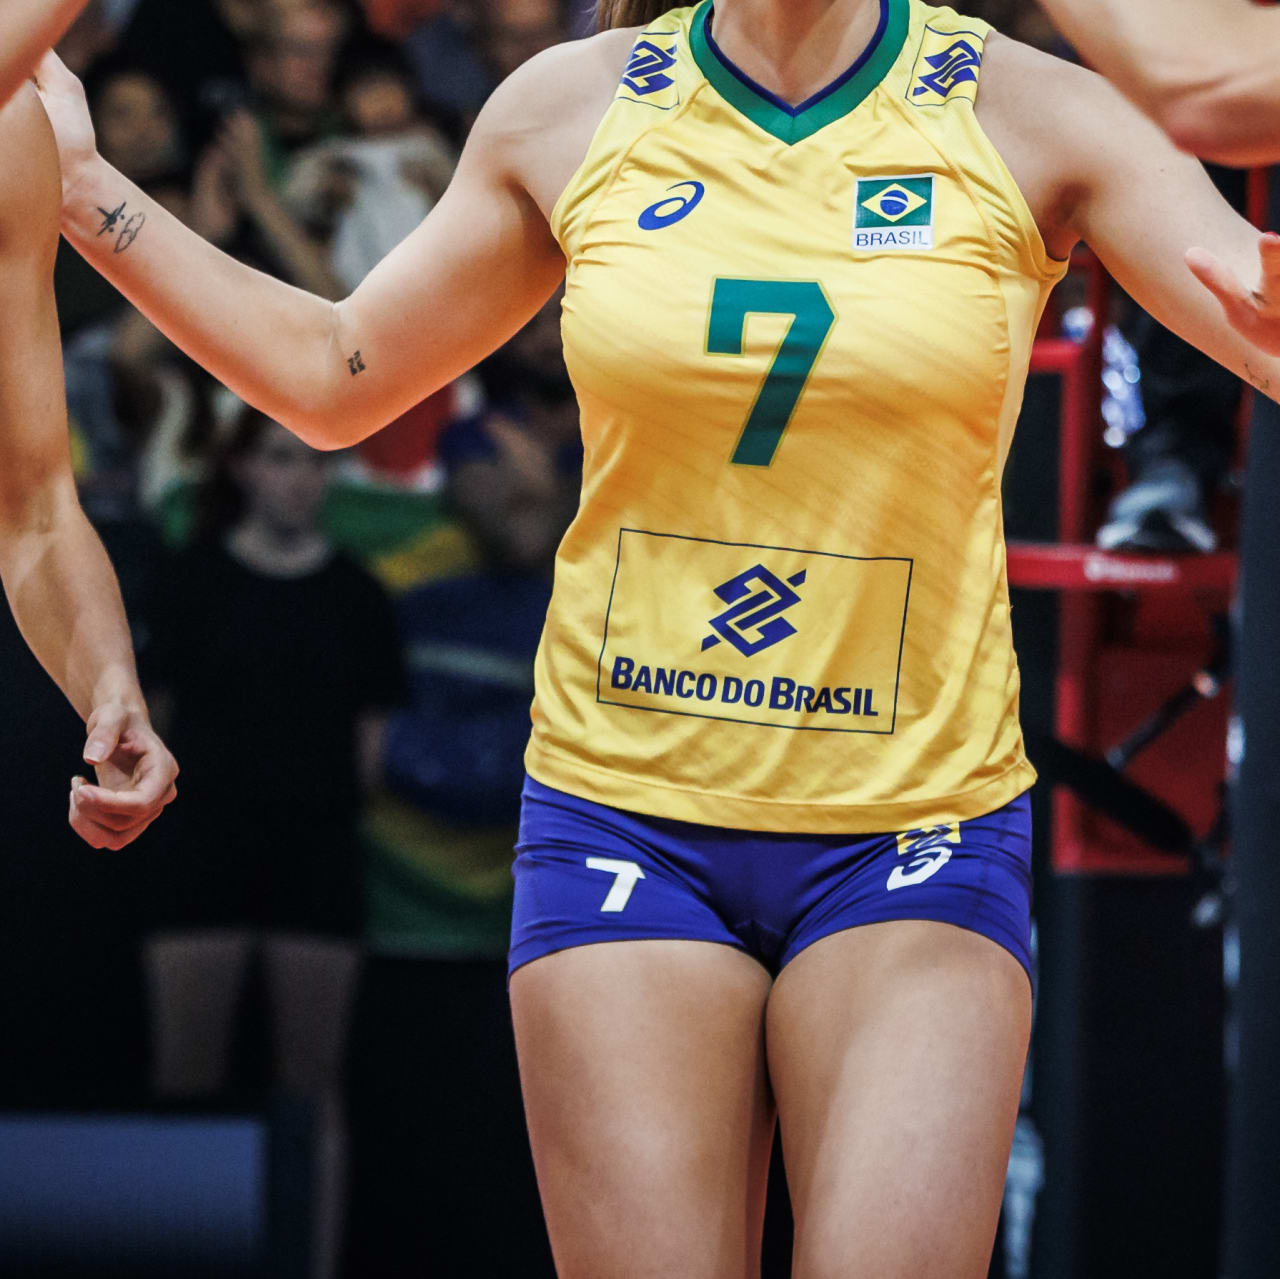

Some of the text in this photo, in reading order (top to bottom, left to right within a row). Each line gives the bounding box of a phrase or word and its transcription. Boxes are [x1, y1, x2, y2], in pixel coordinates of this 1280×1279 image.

[855, 230, 929, 247] BRASIL
[706, 277, 837, 468] 7
[610, 655, 879, 717] BANCO DO BRASIL
[585, 856, 647, 913] 7
